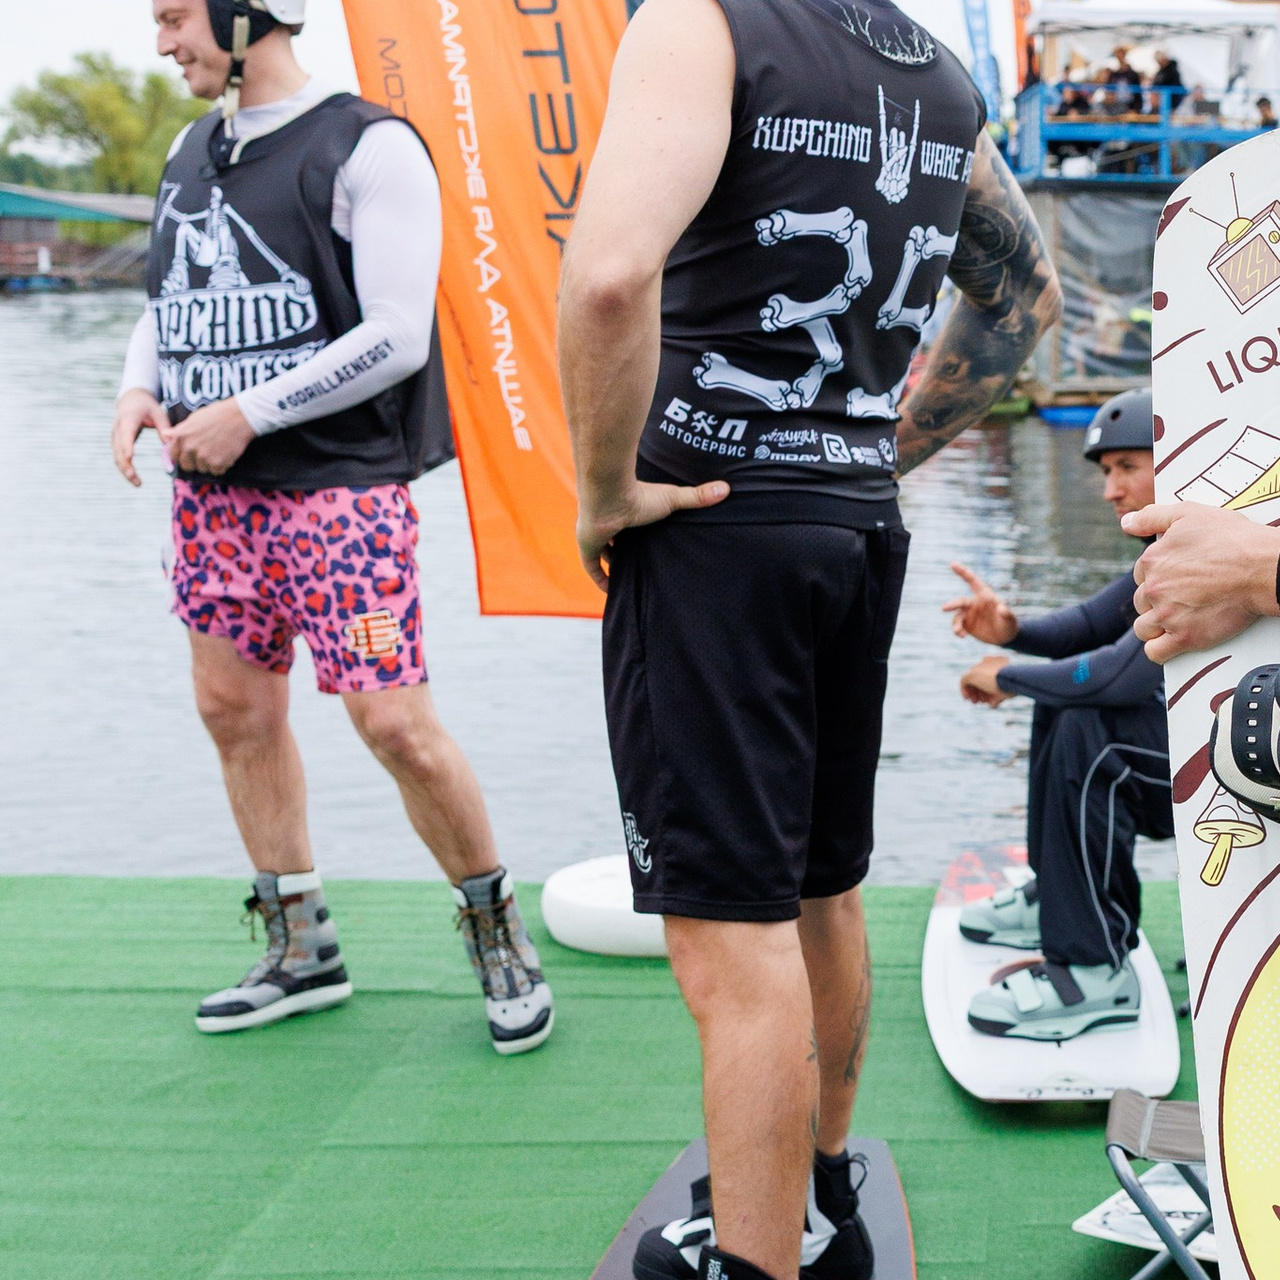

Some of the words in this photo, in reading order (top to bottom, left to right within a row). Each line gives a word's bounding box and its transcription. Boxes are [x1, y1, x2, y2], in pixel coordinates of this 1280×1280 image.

[752, 116, 873, 163] KUPCHINO
[920, 140, 964, 180] WAKE
[659, 421, 747, 459] АВТОСЕРВИС
